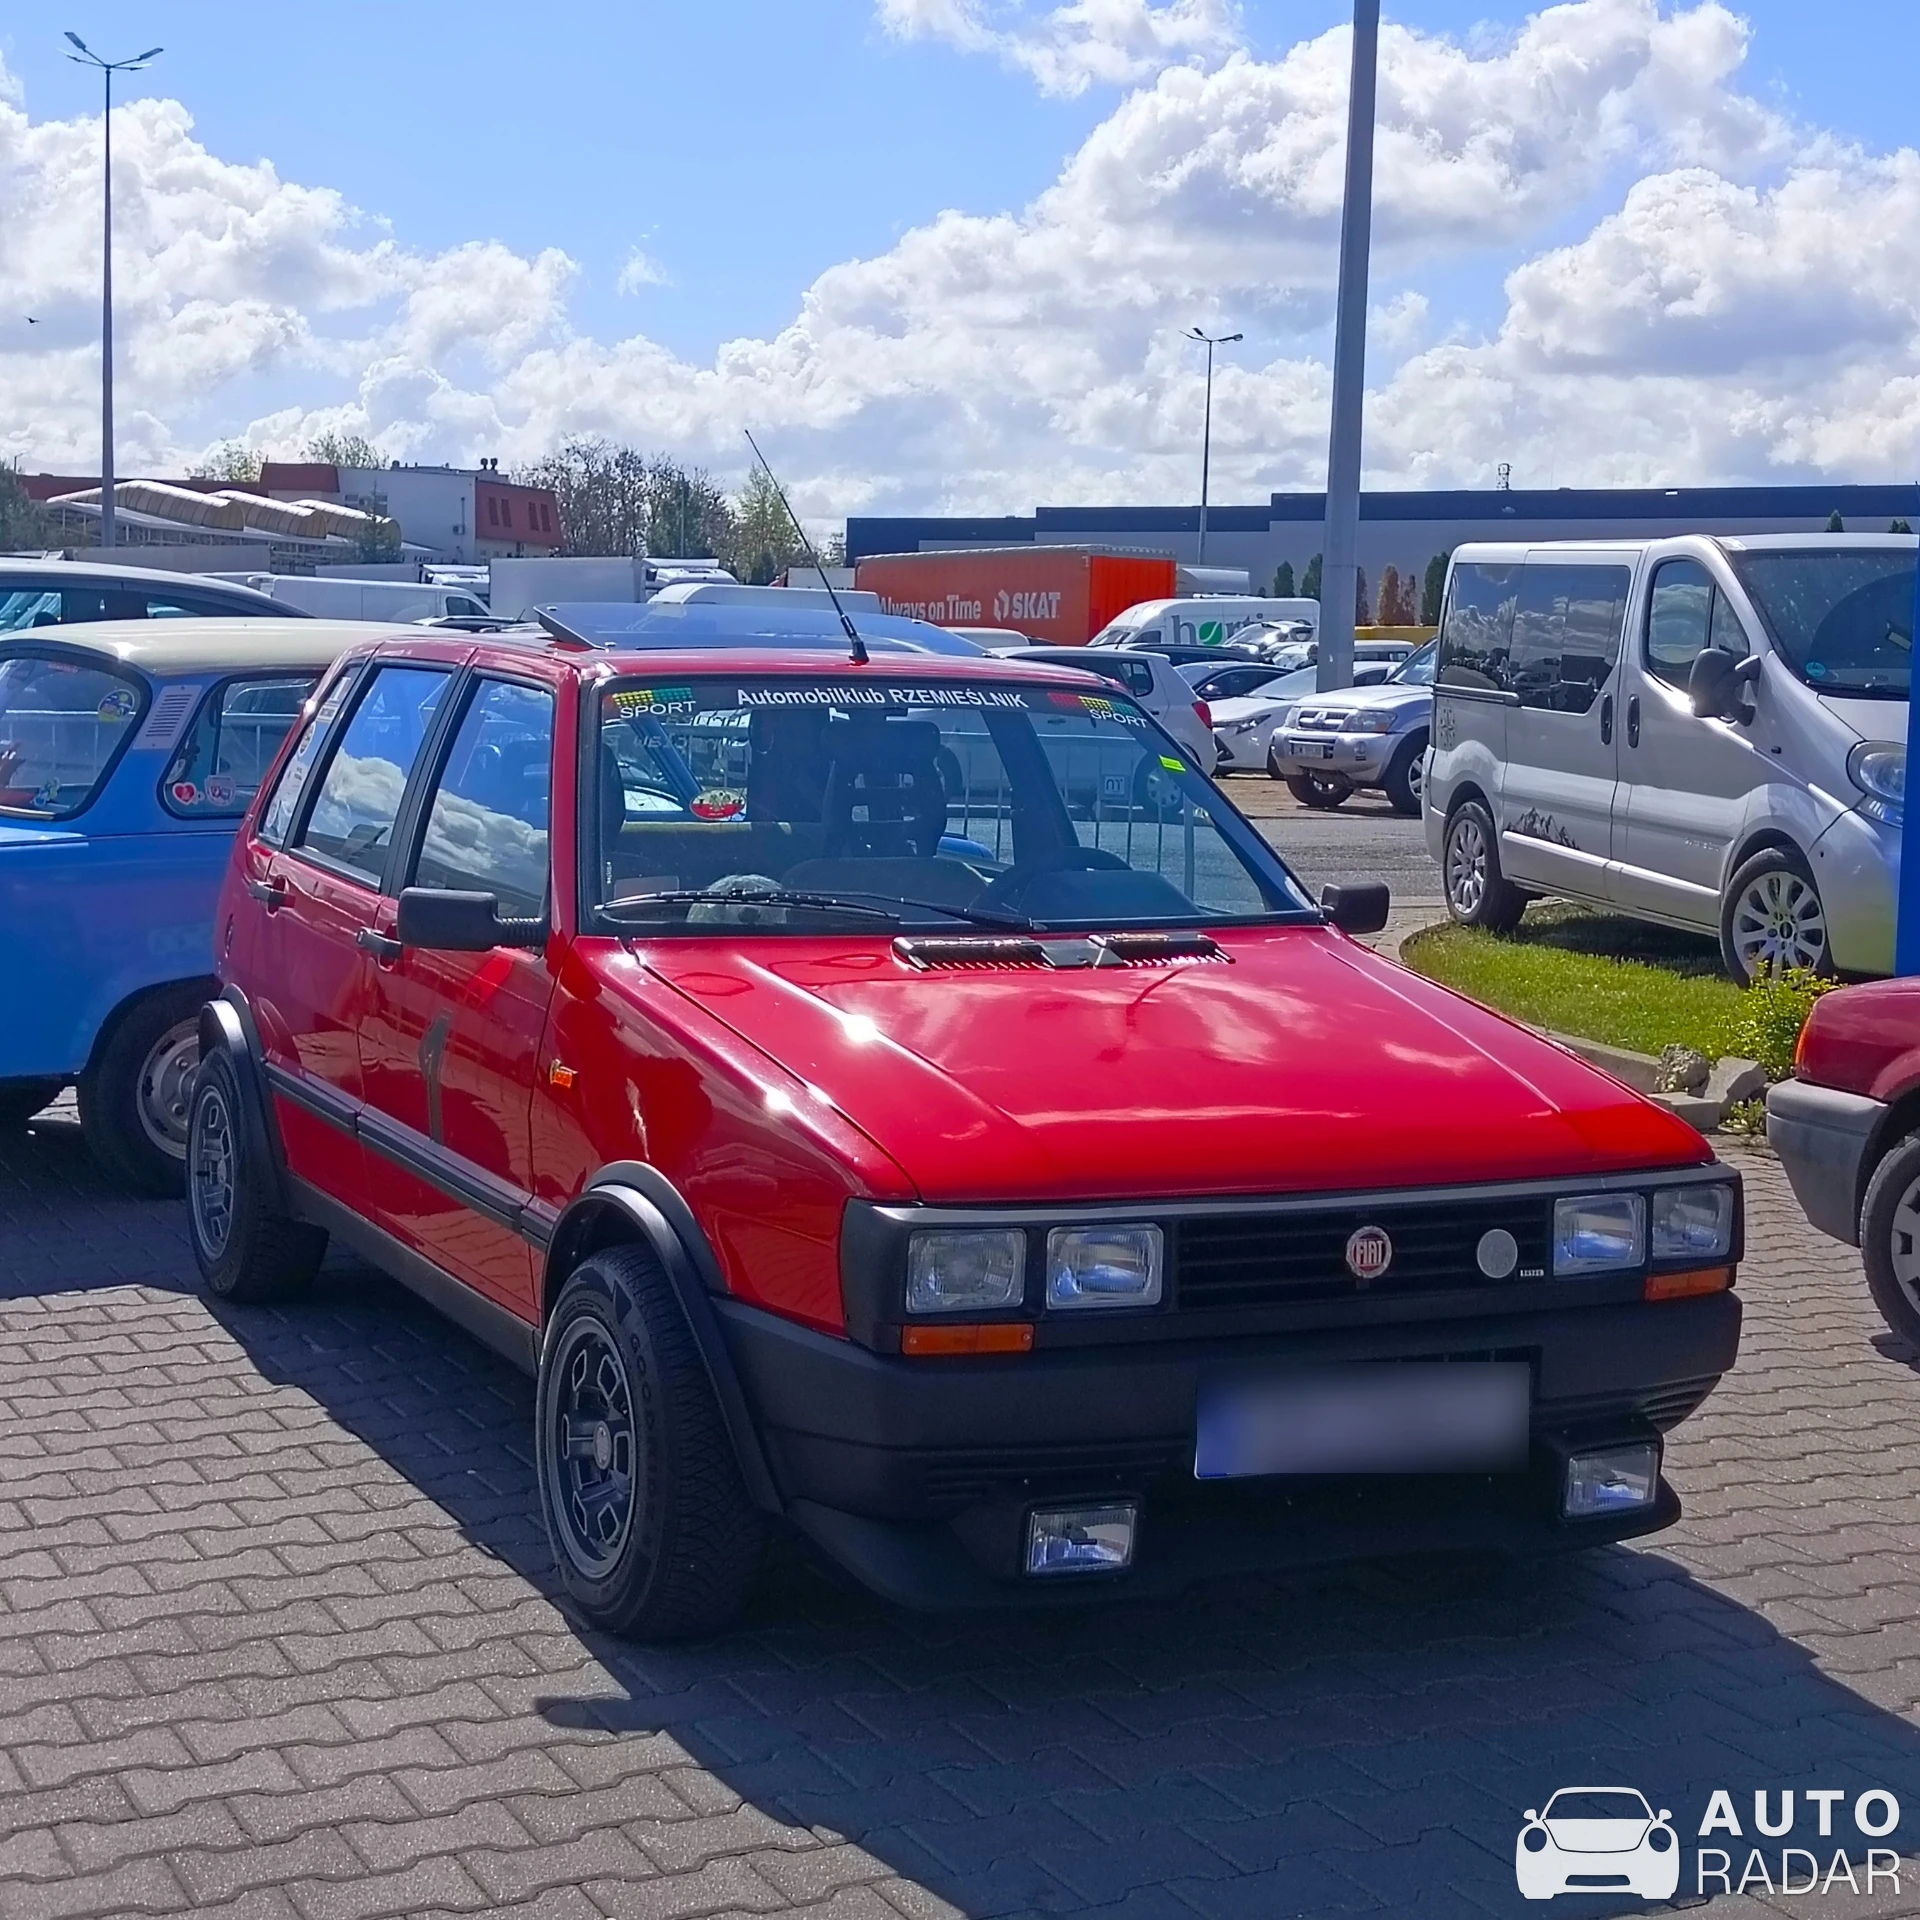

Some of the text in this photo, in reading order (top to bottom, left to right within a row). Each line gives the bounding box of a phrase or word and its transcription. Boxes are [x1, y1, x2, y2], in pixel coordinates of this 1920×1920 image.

[928, 602, 945, 621] on
[946, 594, 982, 620] Time
[1012, 592, 1061, 619] SKAT
[620, 701, 697, 719] SPORT
[737, 687, 1029, 709] Automobilklub RZEMIEŚLNIK
[1089, 708, 1148, 728] SPORT
[1356, 1240, 1384, 1266] FIAT
